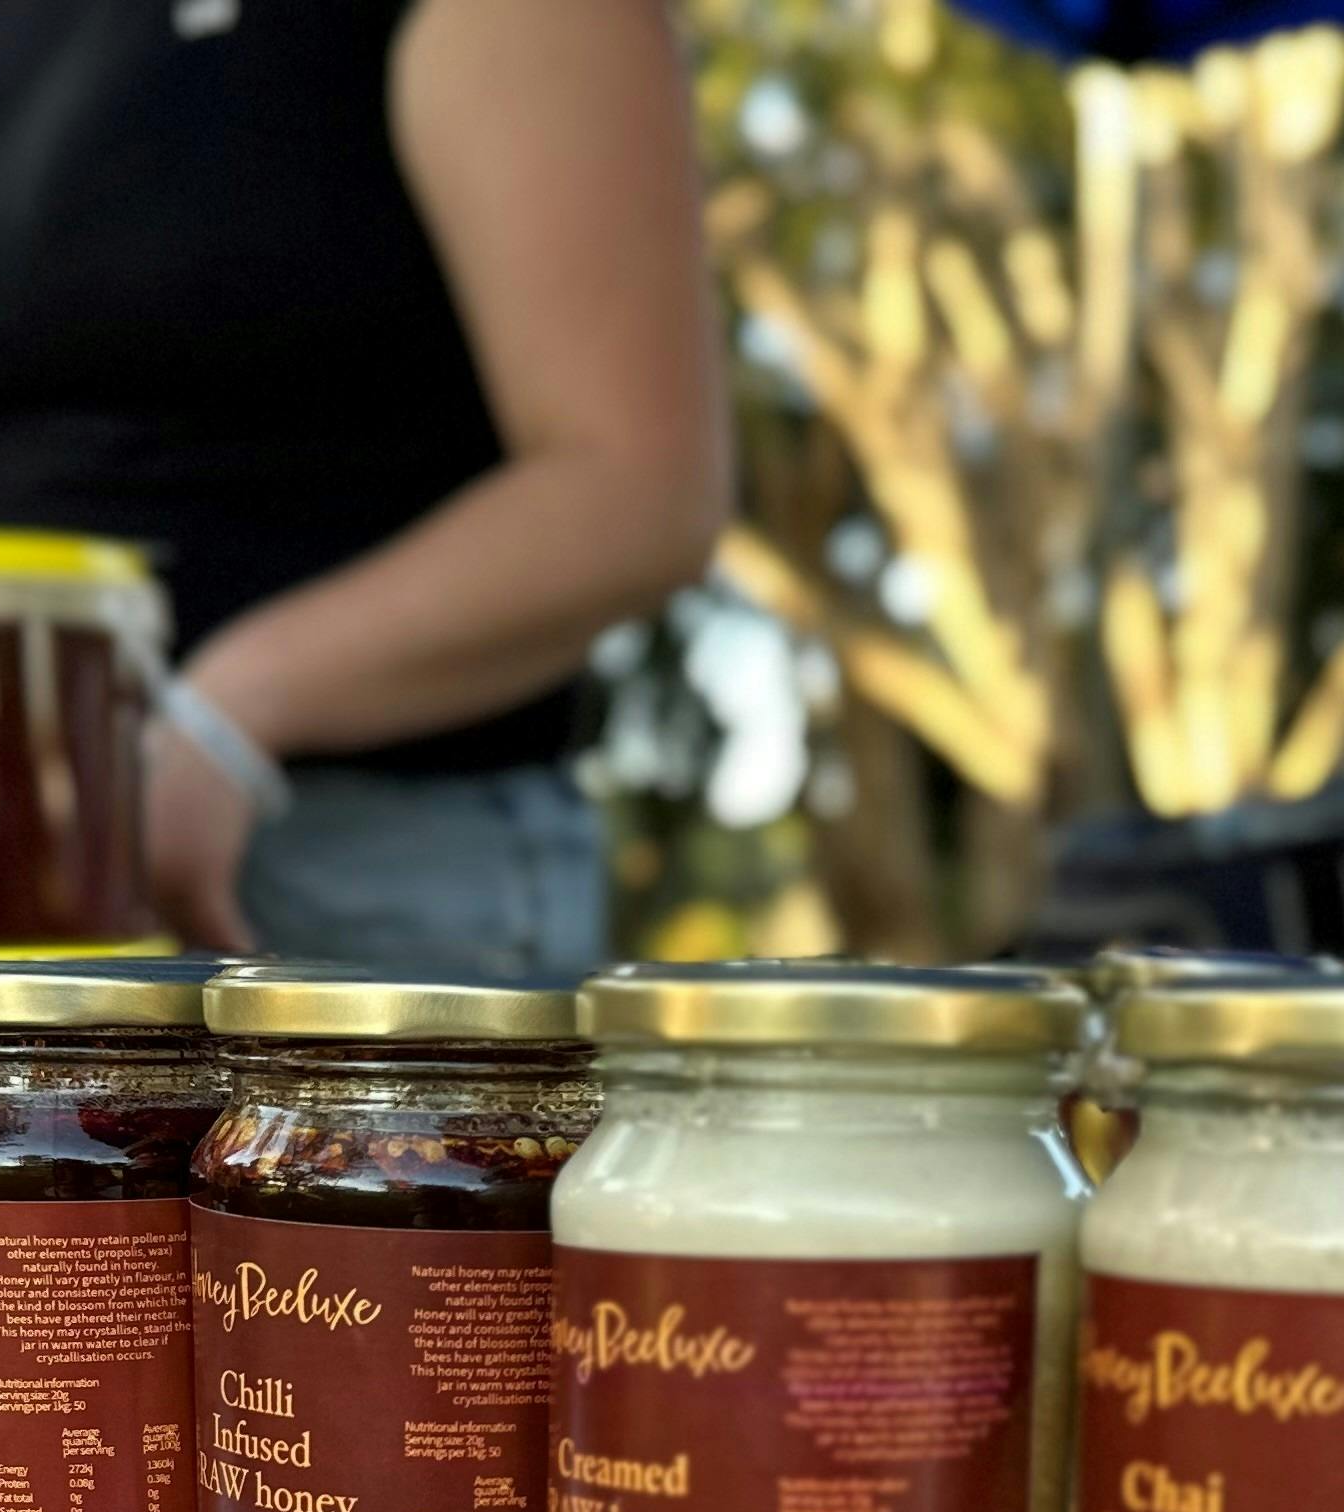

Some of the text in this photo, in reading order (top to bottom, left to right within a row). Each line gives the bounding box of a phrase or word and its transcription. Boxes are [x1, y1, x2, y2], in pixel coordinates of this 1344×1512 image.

[33, 1235, 67, 1248] honey
[71, 1236, 95, 1248] may
[98, 1233, 129, 1245] retain
[132, 1232, 165, 1245] pollen
[168, 1231, 187, 1242] and
[7, 1246, 172, 1260] other elements (propolis, wax)
[23, 1260, 159, 1274] naturally found in honey.
[33, 1275, 53, 1285] will
[56, 1277, 80, 1288] vary
[82, 1274, 120, 1287] greatly
[123, 1273, 132, 1283] in
[136, 1272, 175, 1283] flavour,
[177, 1272, 186, 1280] in
[28, 1287, 49, 1297] and
[52, 1286, 117, 1299] consistency
[120, 1284, 176, 1297] depending
[178, 1284, 191, 1293] on
[18, 1301, 40, 1311] kind
[44, 1301, 56, 1311] of
[59, 1300, 105, 1311] blossom
[108, 1299, 134, 1310] from
[136, 1298, 168, 1309] which
[170, 1298, 186, 1306] the
[7, 1314, 32, 1324] bees
[35, 1314, 61, 1324] have
[64, 1312, 114, 1326] gathered
[116, 1312, 141, 1322] their
[20, 1327, 53, 1340] honey
[56, 1328, 81, 1340] may
[83, 1325, 142, 1338] crystallise,
[144, 1323, 172, 1333] stand
[175, 1322, 191, 1331] the
[20, 1335, 168, 1352] jar in warm water to clear if
[37, 1351, 155, 1366] crystallisation occurs.
[43, 1378, 99, 1388] information
[51, 1391, 70, 1402] 20g
[220, 1370, 295, 1418] Chilli
[35, 1403, 51, 1413] per
[74, 1401, 86, 1411] 50
[213, 1413, 311, 1467] Infused
[558, 1437, 689, 1495] Creamed
[200, 1451, 249, 1501] RAW
